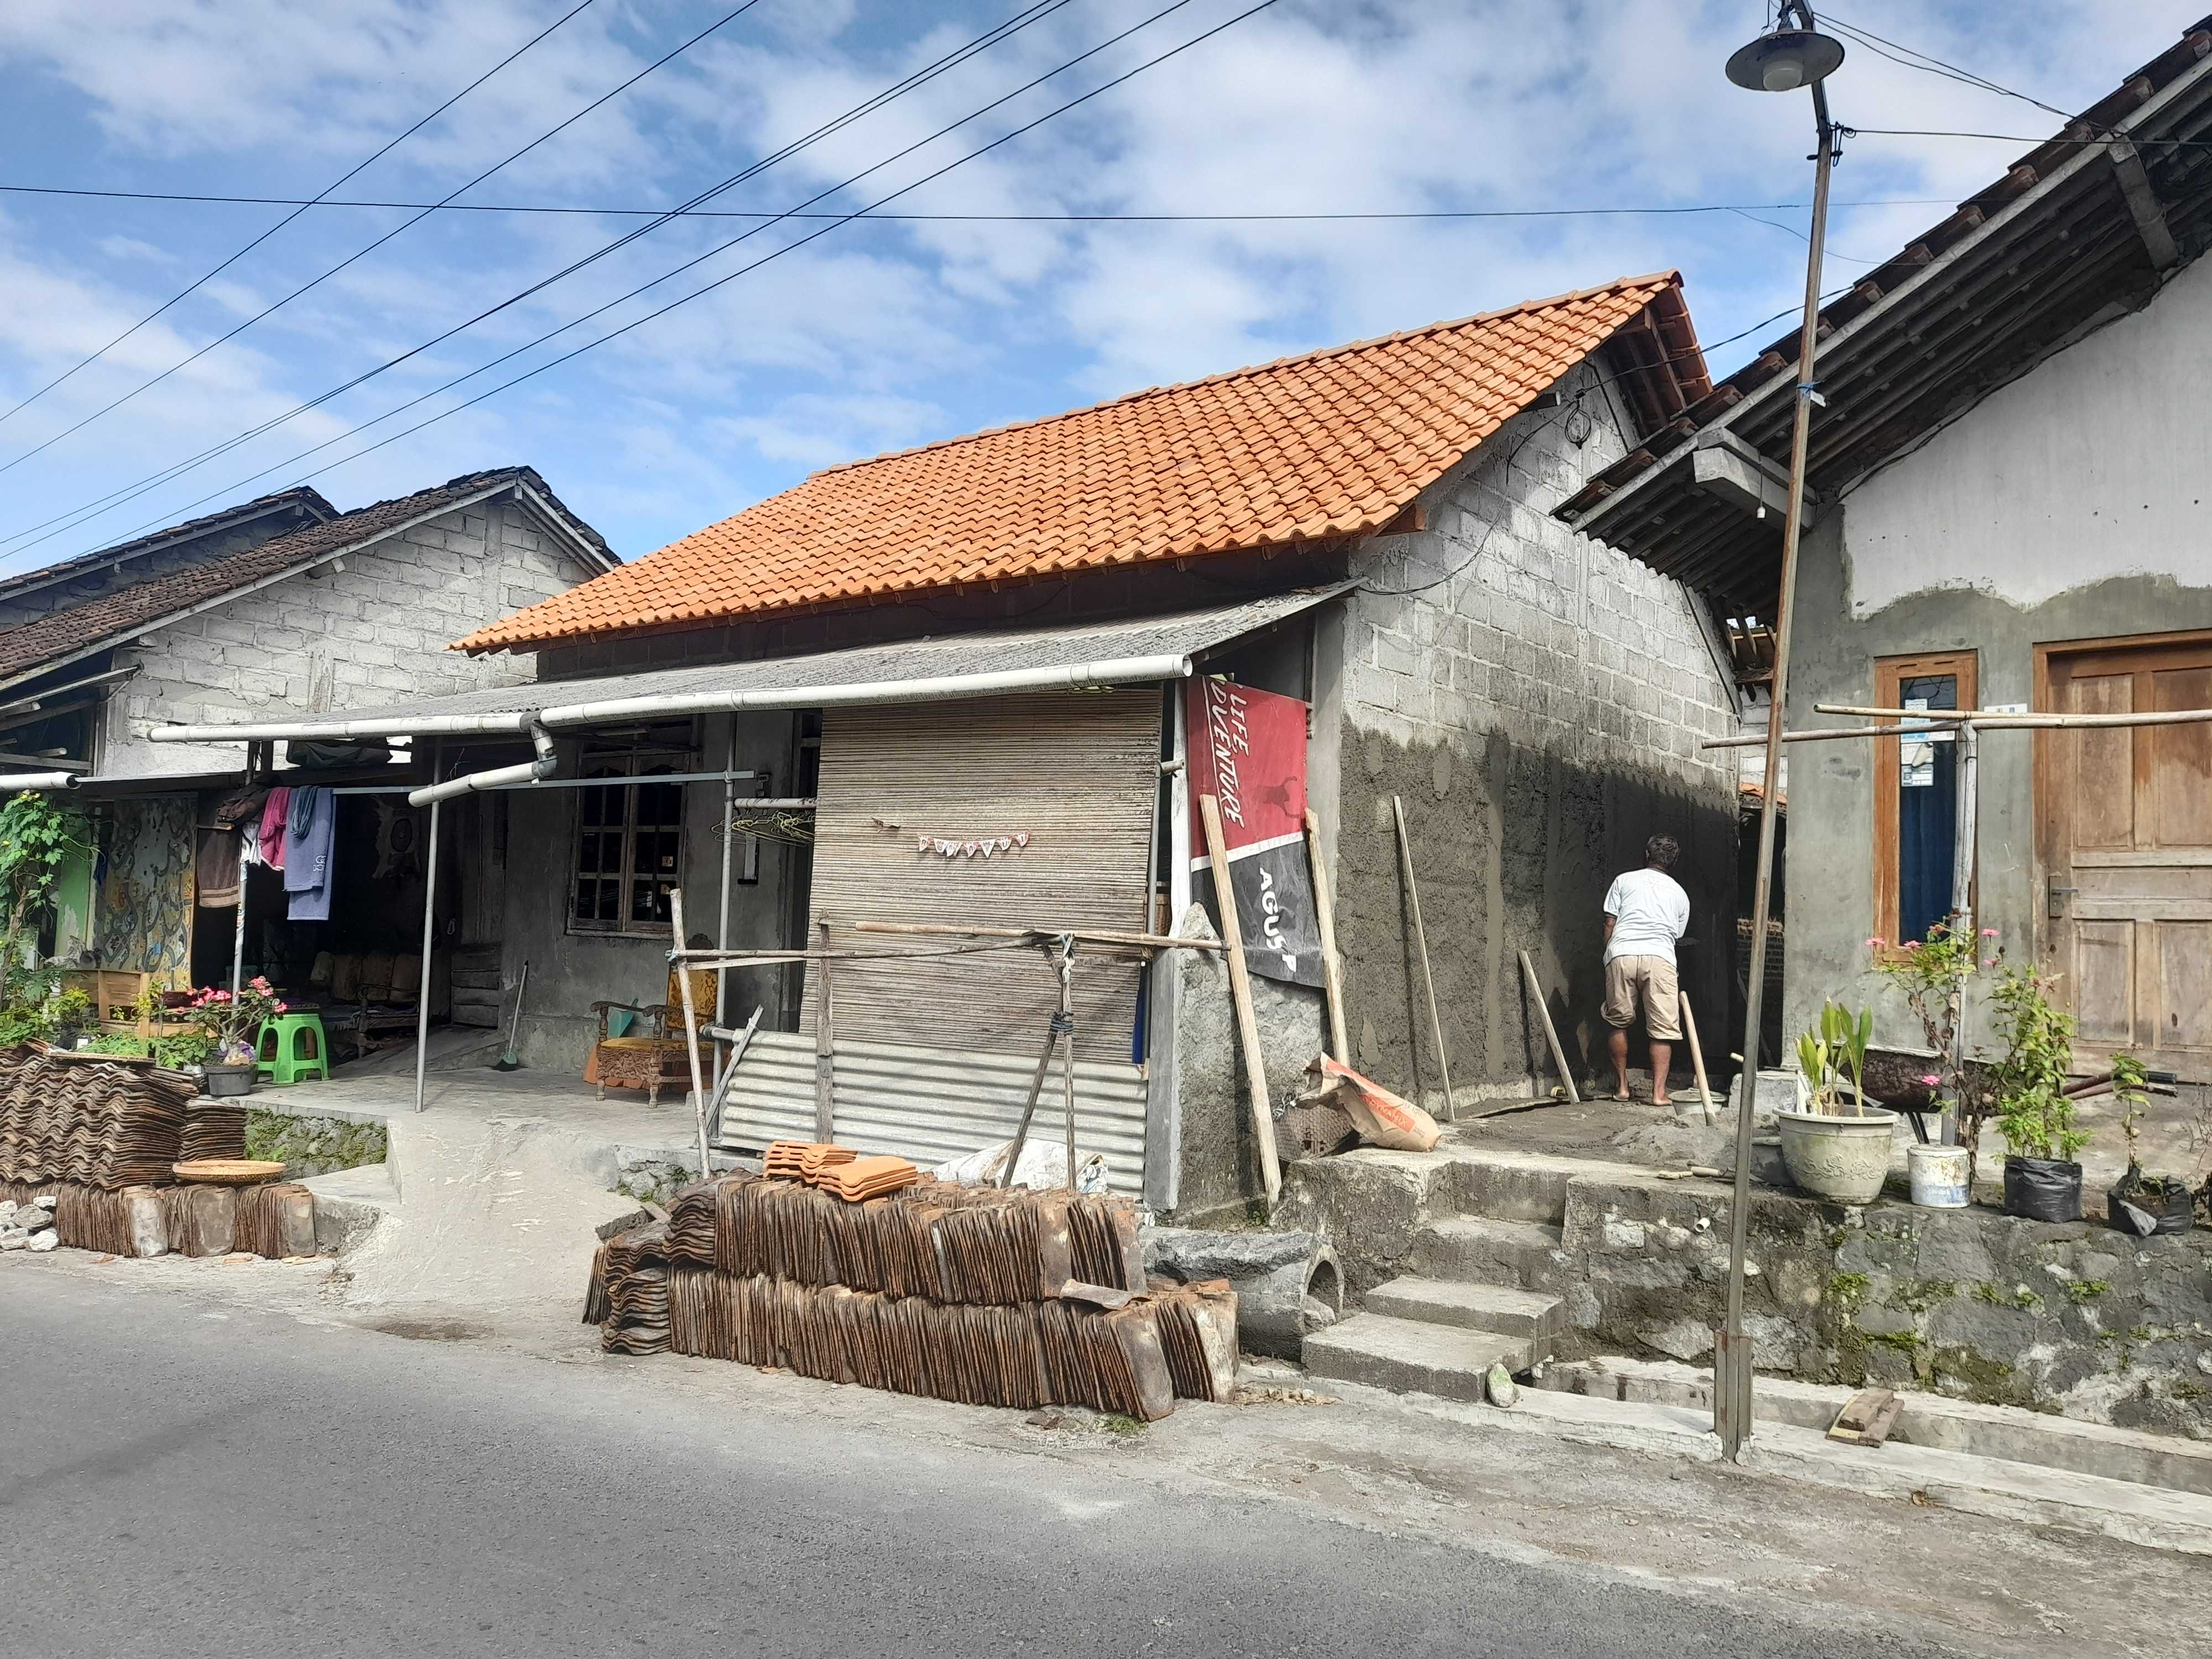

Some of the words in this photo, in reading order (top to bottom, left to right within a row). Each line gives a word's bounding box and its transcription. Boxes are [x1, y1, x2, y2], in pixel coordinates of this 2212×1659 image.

[1211, 680, 1245, 828] DVENTURE
[1230, 693, 1249, 757] LIFE,
[1260, 867, 1288, 950] AGUS
